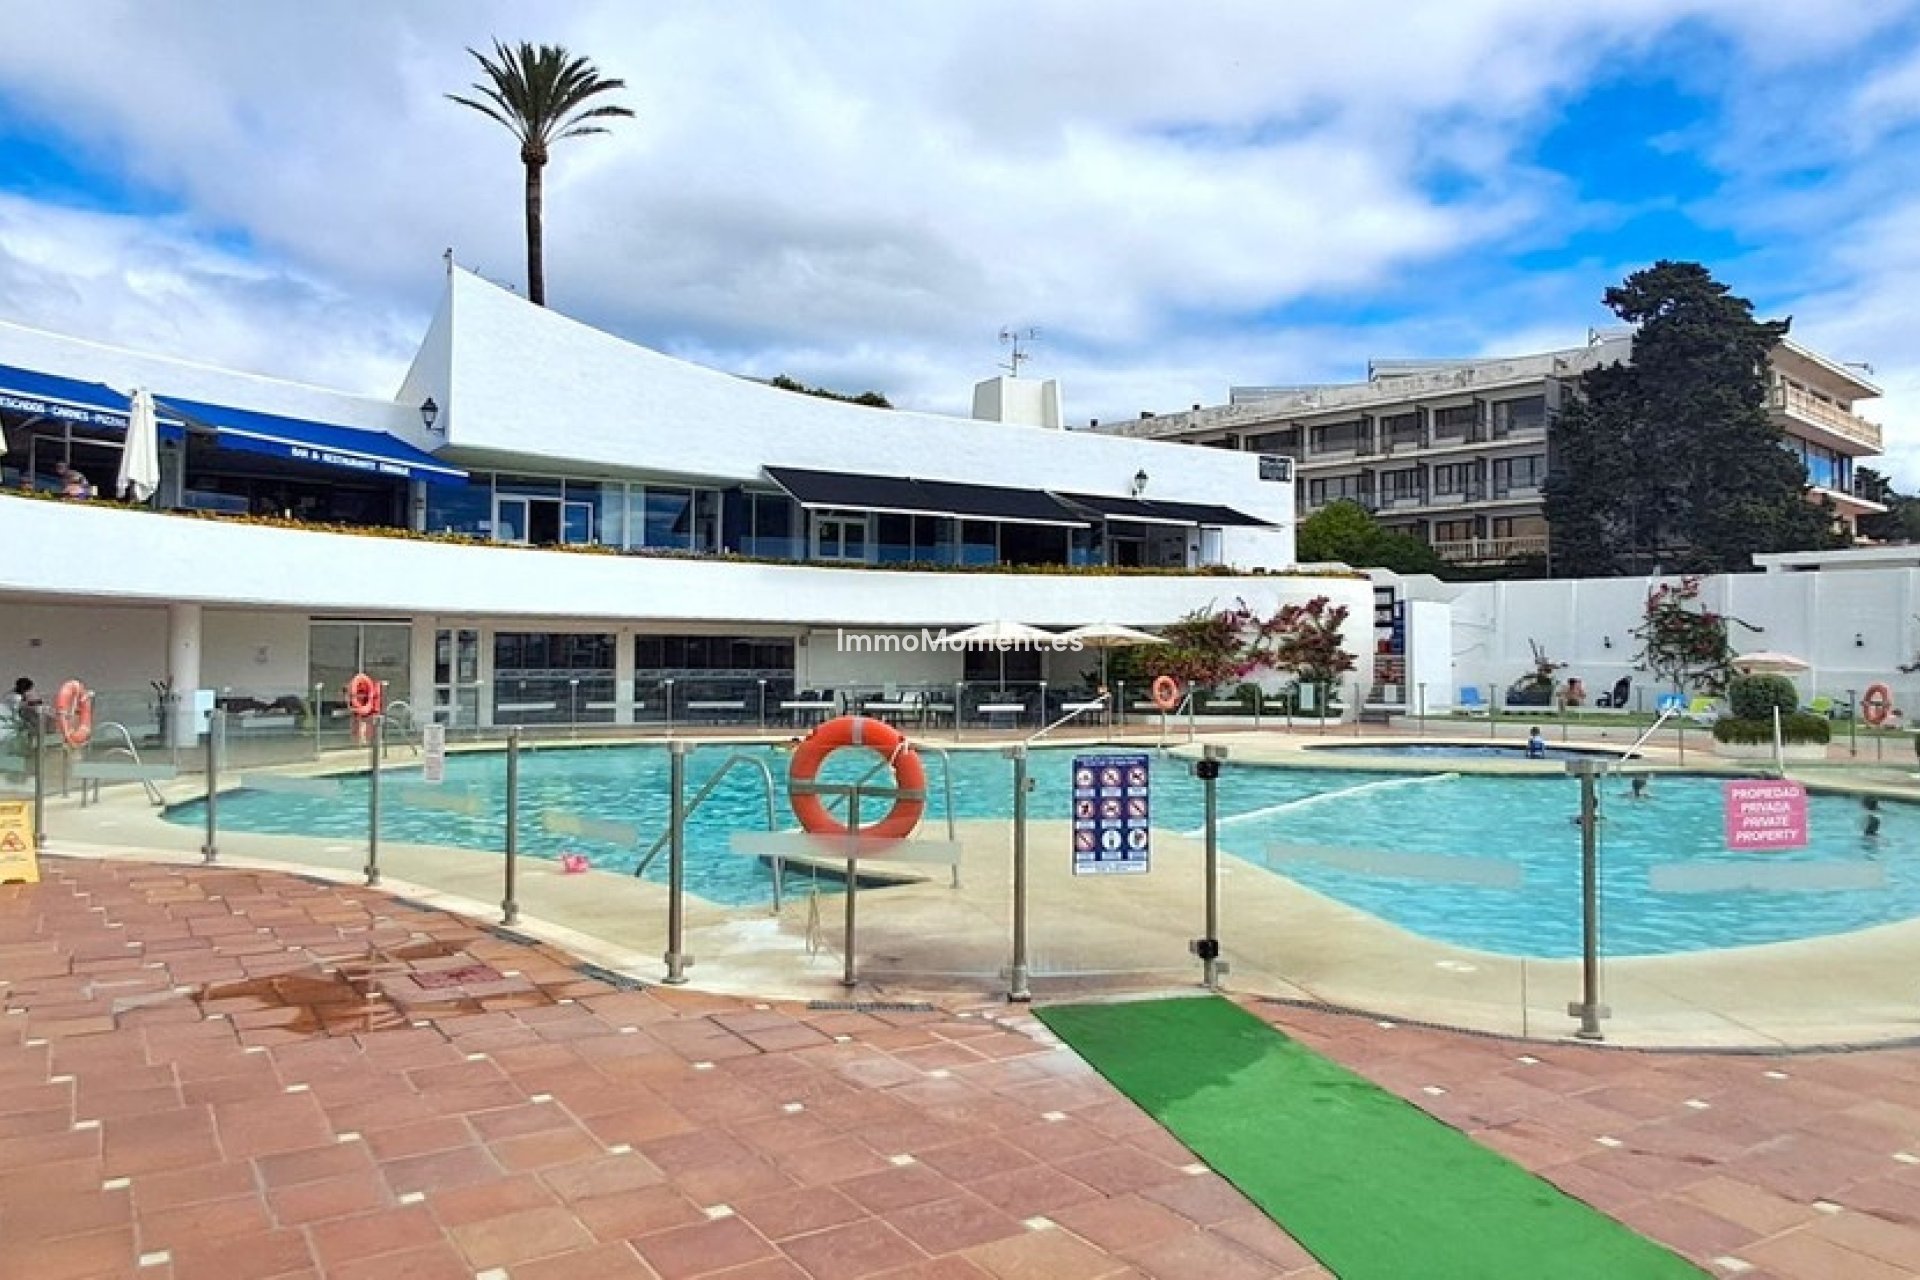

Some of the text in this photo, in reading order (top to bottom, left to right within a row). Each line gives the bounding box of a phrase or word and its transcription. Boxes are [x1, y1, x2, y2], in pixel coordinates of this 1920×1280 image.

[1731, 787, 1800, 800] PROPIEDAD
[1740, 801, 1791, 814] PRIVADA
[1742, 815, 1790, 828] PRIVATE
[1735, 828, 1800, 843] PROPERTY
